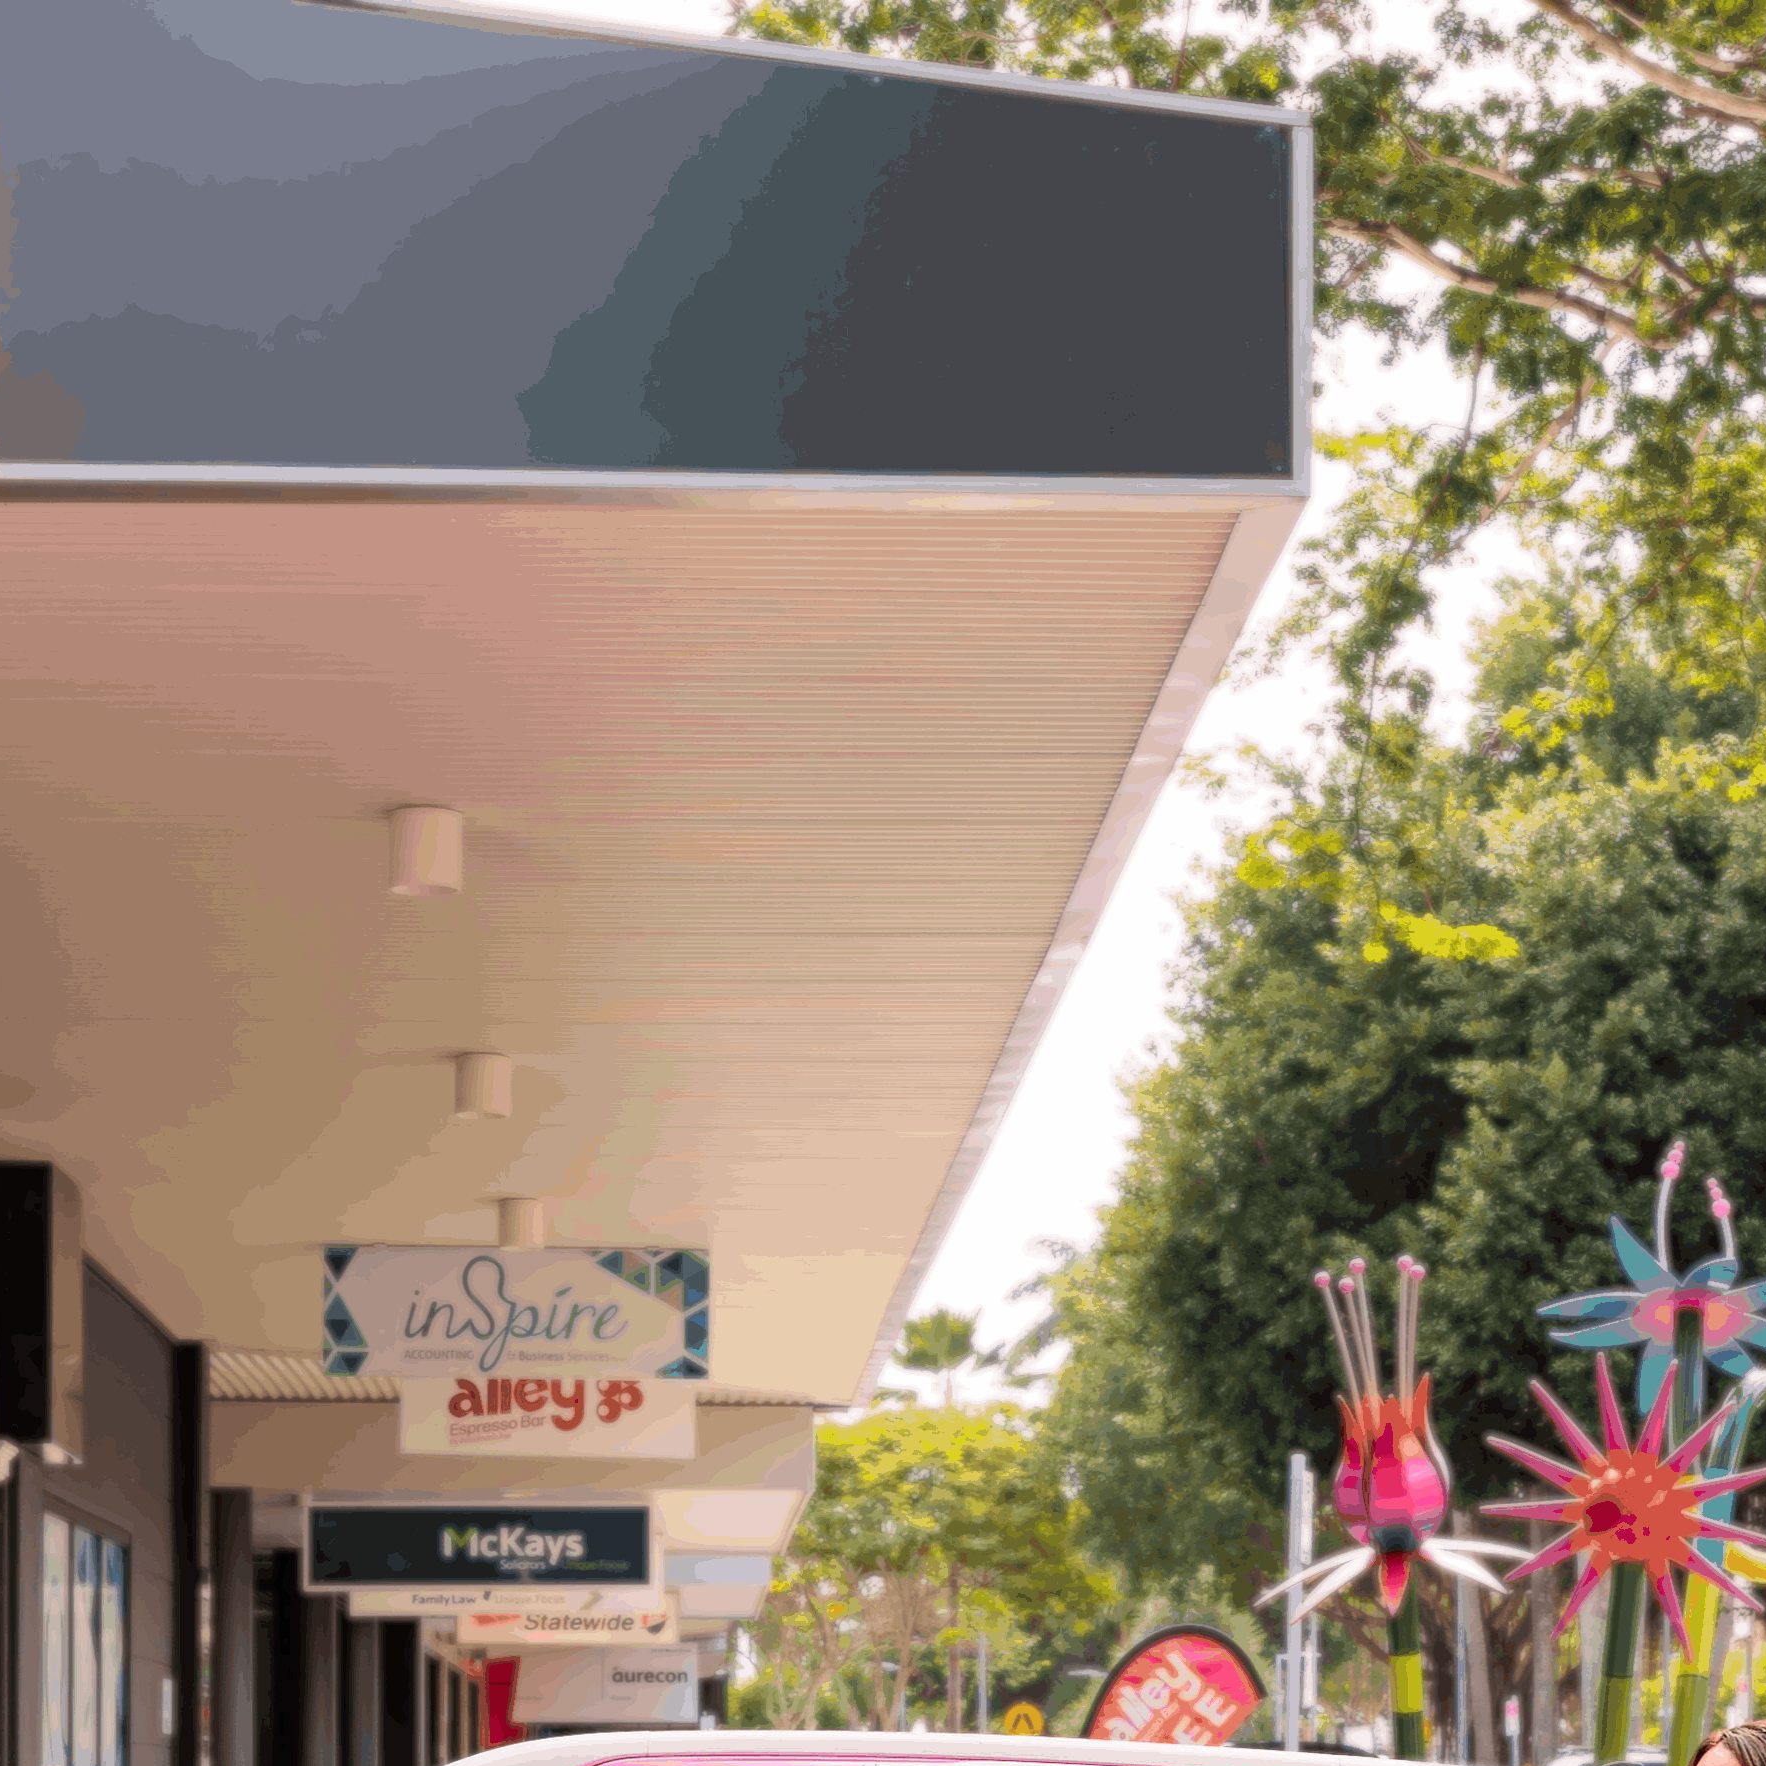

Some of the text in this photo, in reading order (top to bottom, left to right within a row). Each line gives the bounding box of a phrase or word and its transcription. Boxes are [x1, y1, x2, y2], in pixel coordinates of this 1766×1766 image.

[404, 1349, 474, 1361] ACCOUNTING
[518, 1351, 564, 1362] Business
[567, 1352, 610, 1362] Services
[448, 1379, 584, 1431] alley
[449, 1415, 546, 1436] Espresso Bar
[440, 1527, 584, 1566] McKays
[412, 1594, 451, 1607] Family
[452, 1594, 477, 1605] Law
[524, 1614, 634, 1631] Statewide
[612, 1669, 689, 1684] aurecon
[1104, 1653, 1202, 1742] alley
